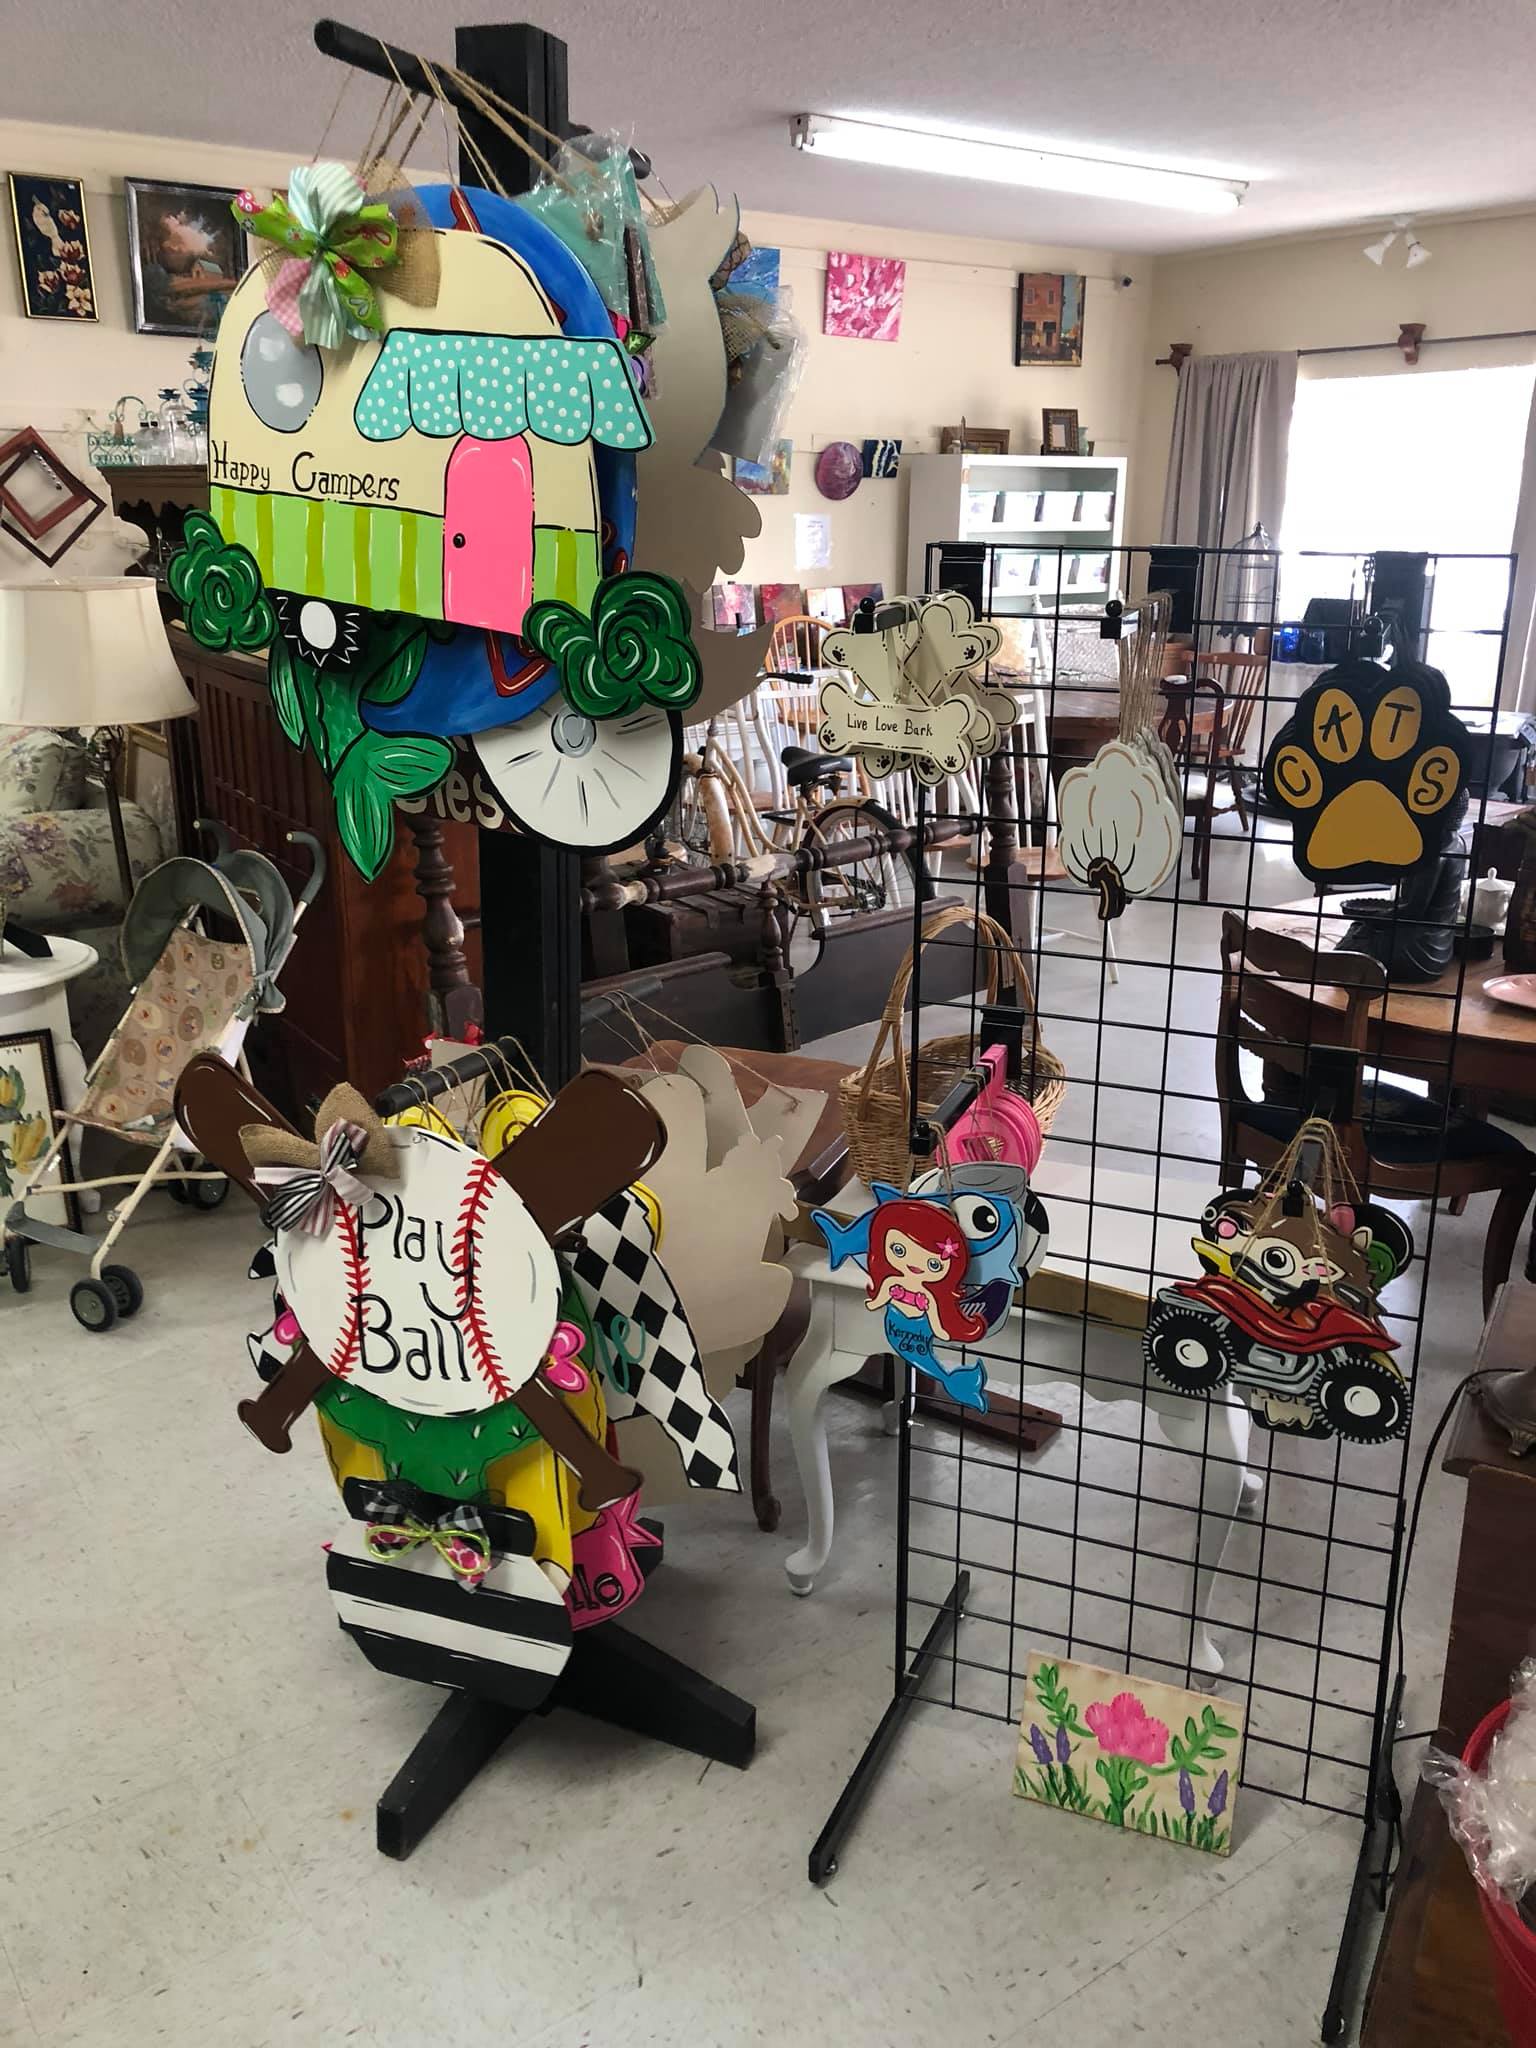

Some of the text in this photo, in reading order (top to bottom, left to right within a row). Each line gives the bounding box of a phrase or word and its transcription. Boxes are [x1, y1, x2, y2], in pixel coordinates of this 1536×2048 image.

[211, 440, 400, 501] Happy Campers
[847, 712, 933, 736] Live Love Bark
[1277, 702, 1449, 806] CATS
[356, 1192, 475, 1321] Play
[350, 1293, 471, 1381] Ball
